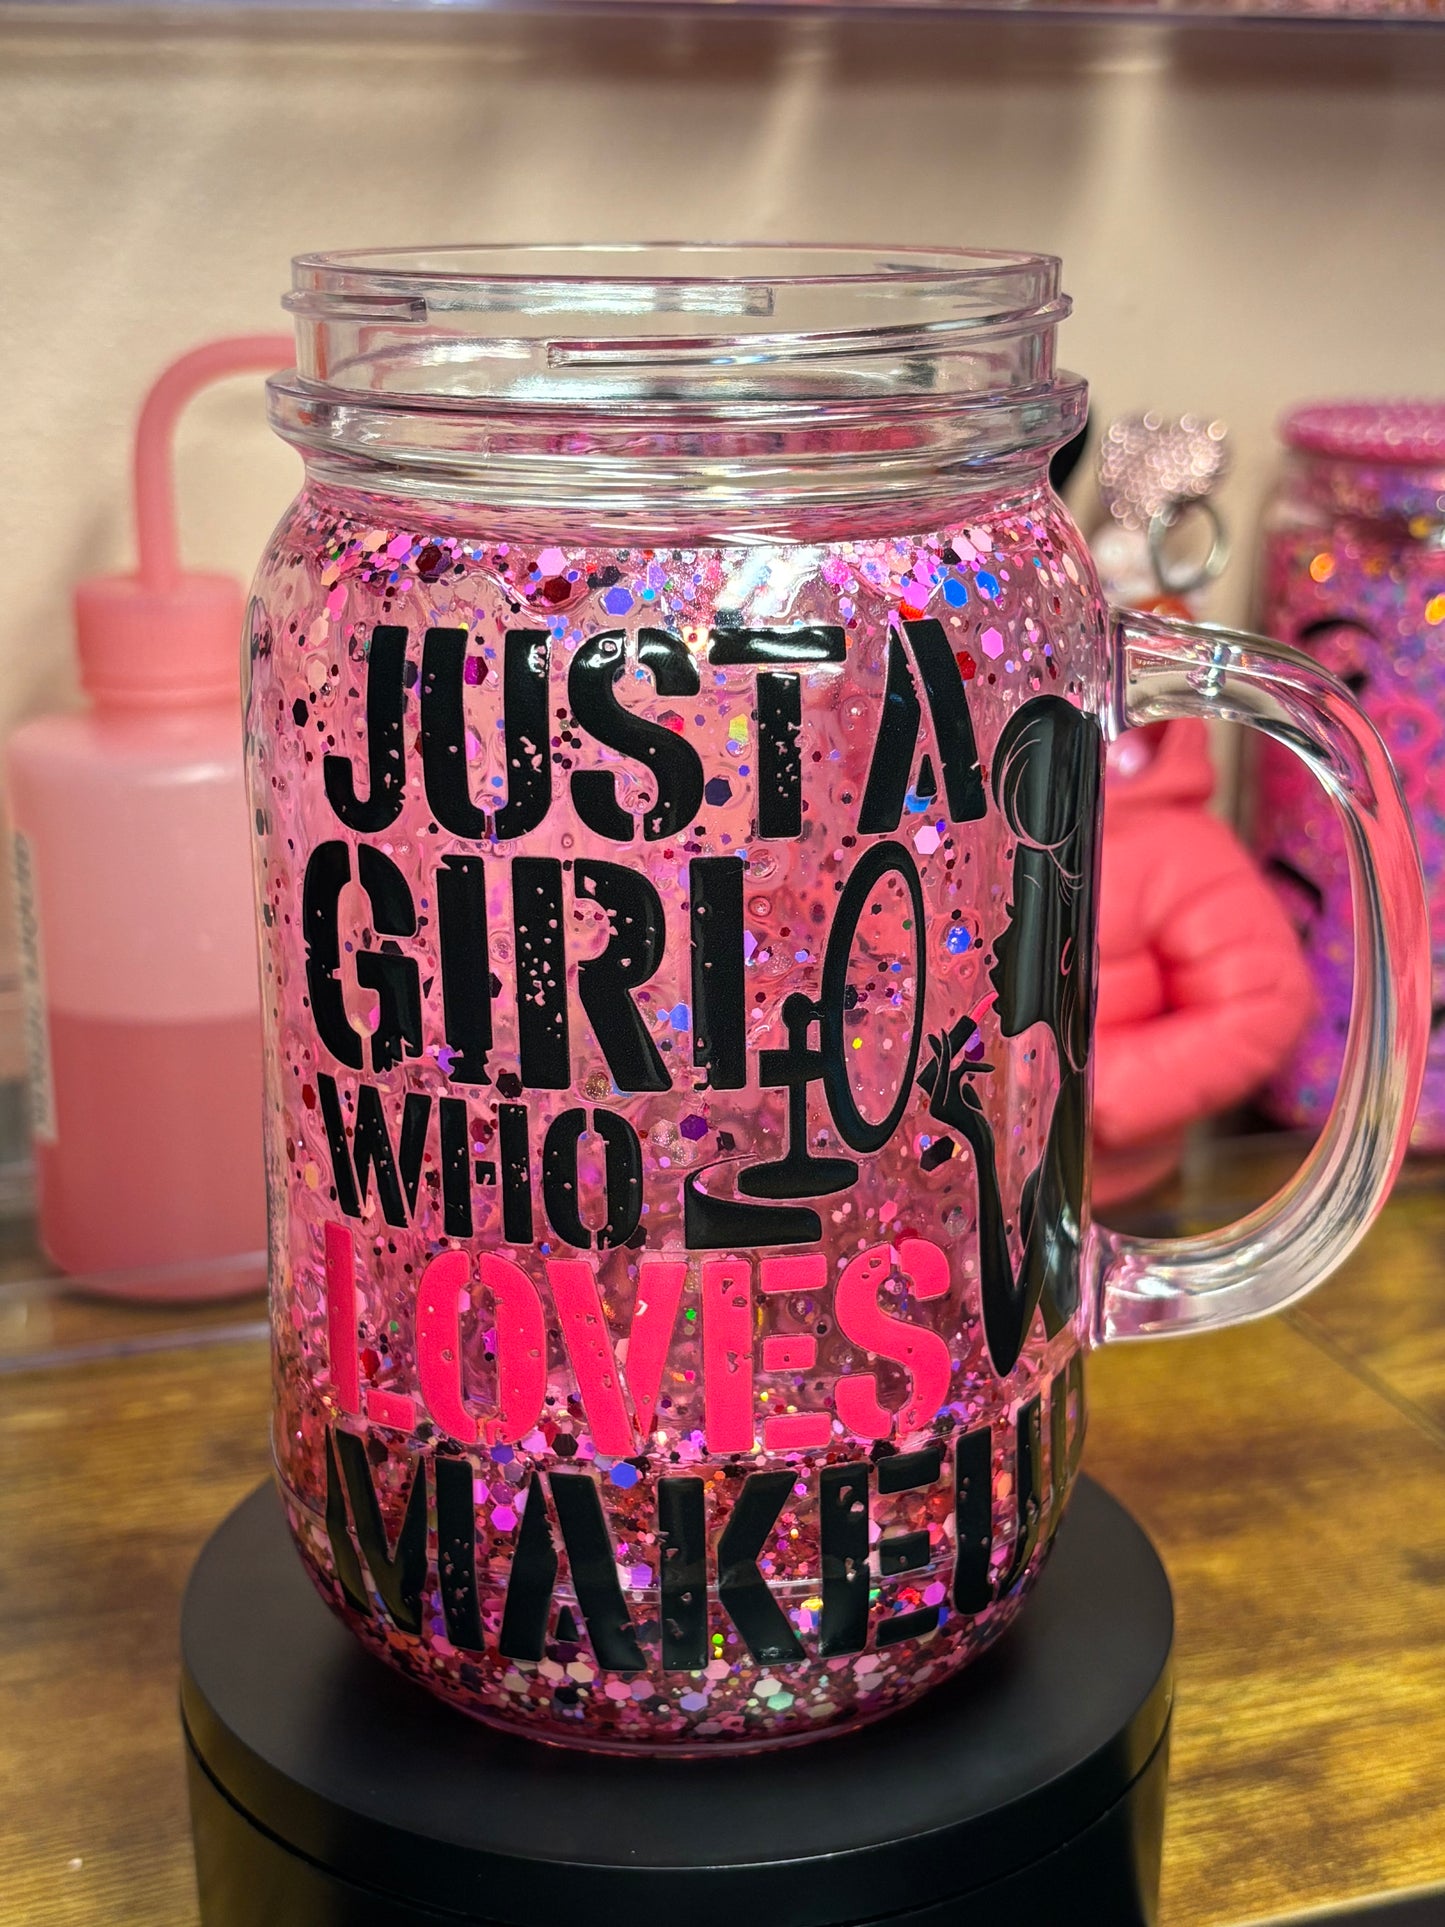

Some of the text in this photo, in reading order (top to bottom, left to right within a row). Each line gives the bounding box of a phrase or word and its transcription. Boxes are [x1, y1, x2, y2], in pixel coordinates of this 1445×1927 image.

[322, 617, 988, 842] JUST A
[302, 839, 825, 1093] GIRL
[316, 1072, 644, 1250] WHO
[324, 1219, 953, 1458] LOVES
